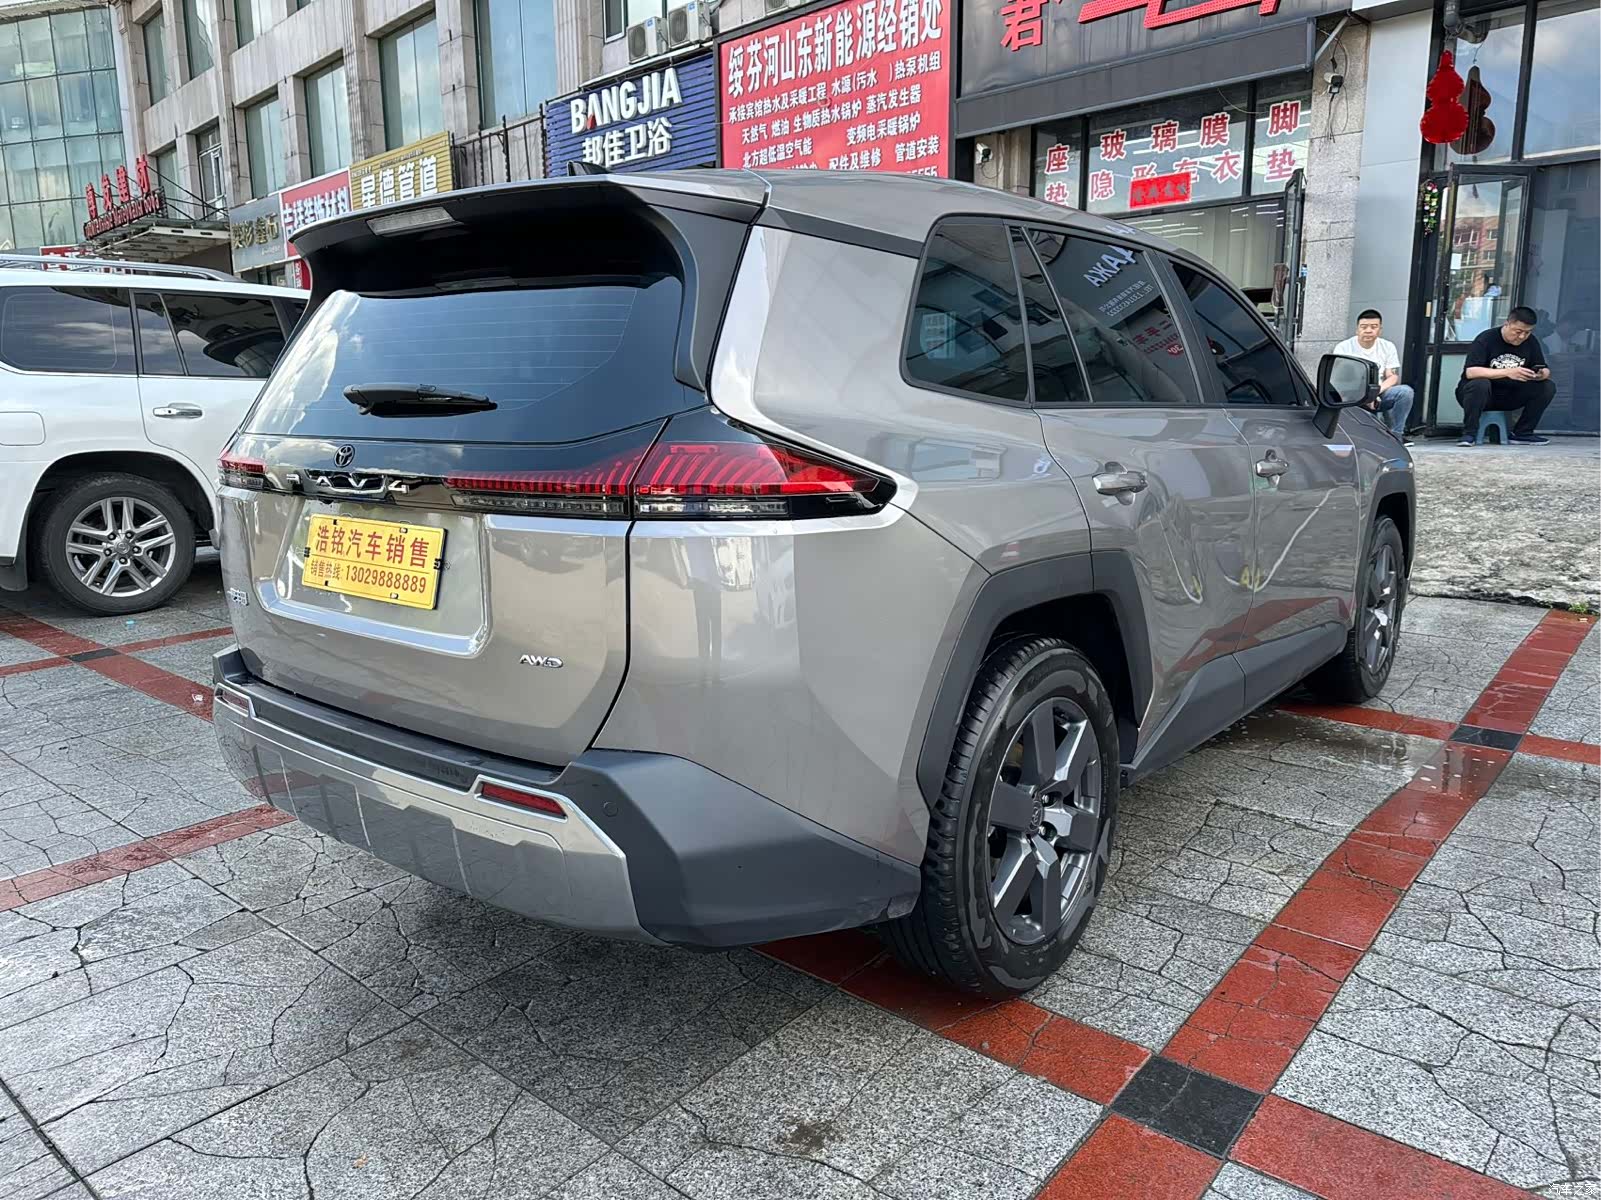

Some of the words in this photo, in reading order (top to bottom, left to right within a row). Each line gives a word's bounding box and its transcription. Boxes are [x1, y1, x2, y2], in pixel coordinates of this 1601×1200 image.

[728, 0, 942, 98] 绥芬河山东新能源经销处
[570, 67, 683, 134] BANGJIA
[741, 123, 768, 145] 天然气
[771, 117, 790, 137] 燃油
[793, 98, 862, 133] 生物质热水锅炉
[866, 83, 921, 114] 蒸汽发生器
[582, 116, 672, 168] 邦佳卫浴
[742, 137, 812, 169] 北方超低温空气能
[846, 111, 921, 146] 变频电采暖锅炉
[828, 148, 881, 170] 配件及维修
[894, 135, 940, 163] 管道安装
[1101, 114, 1230, 161] 玻璃膜
[315, 525, 430, 570] 浩铭汽车销售
[345, 564, 427, 594] 13029888889
[520, 654, 563, 668] AWD
